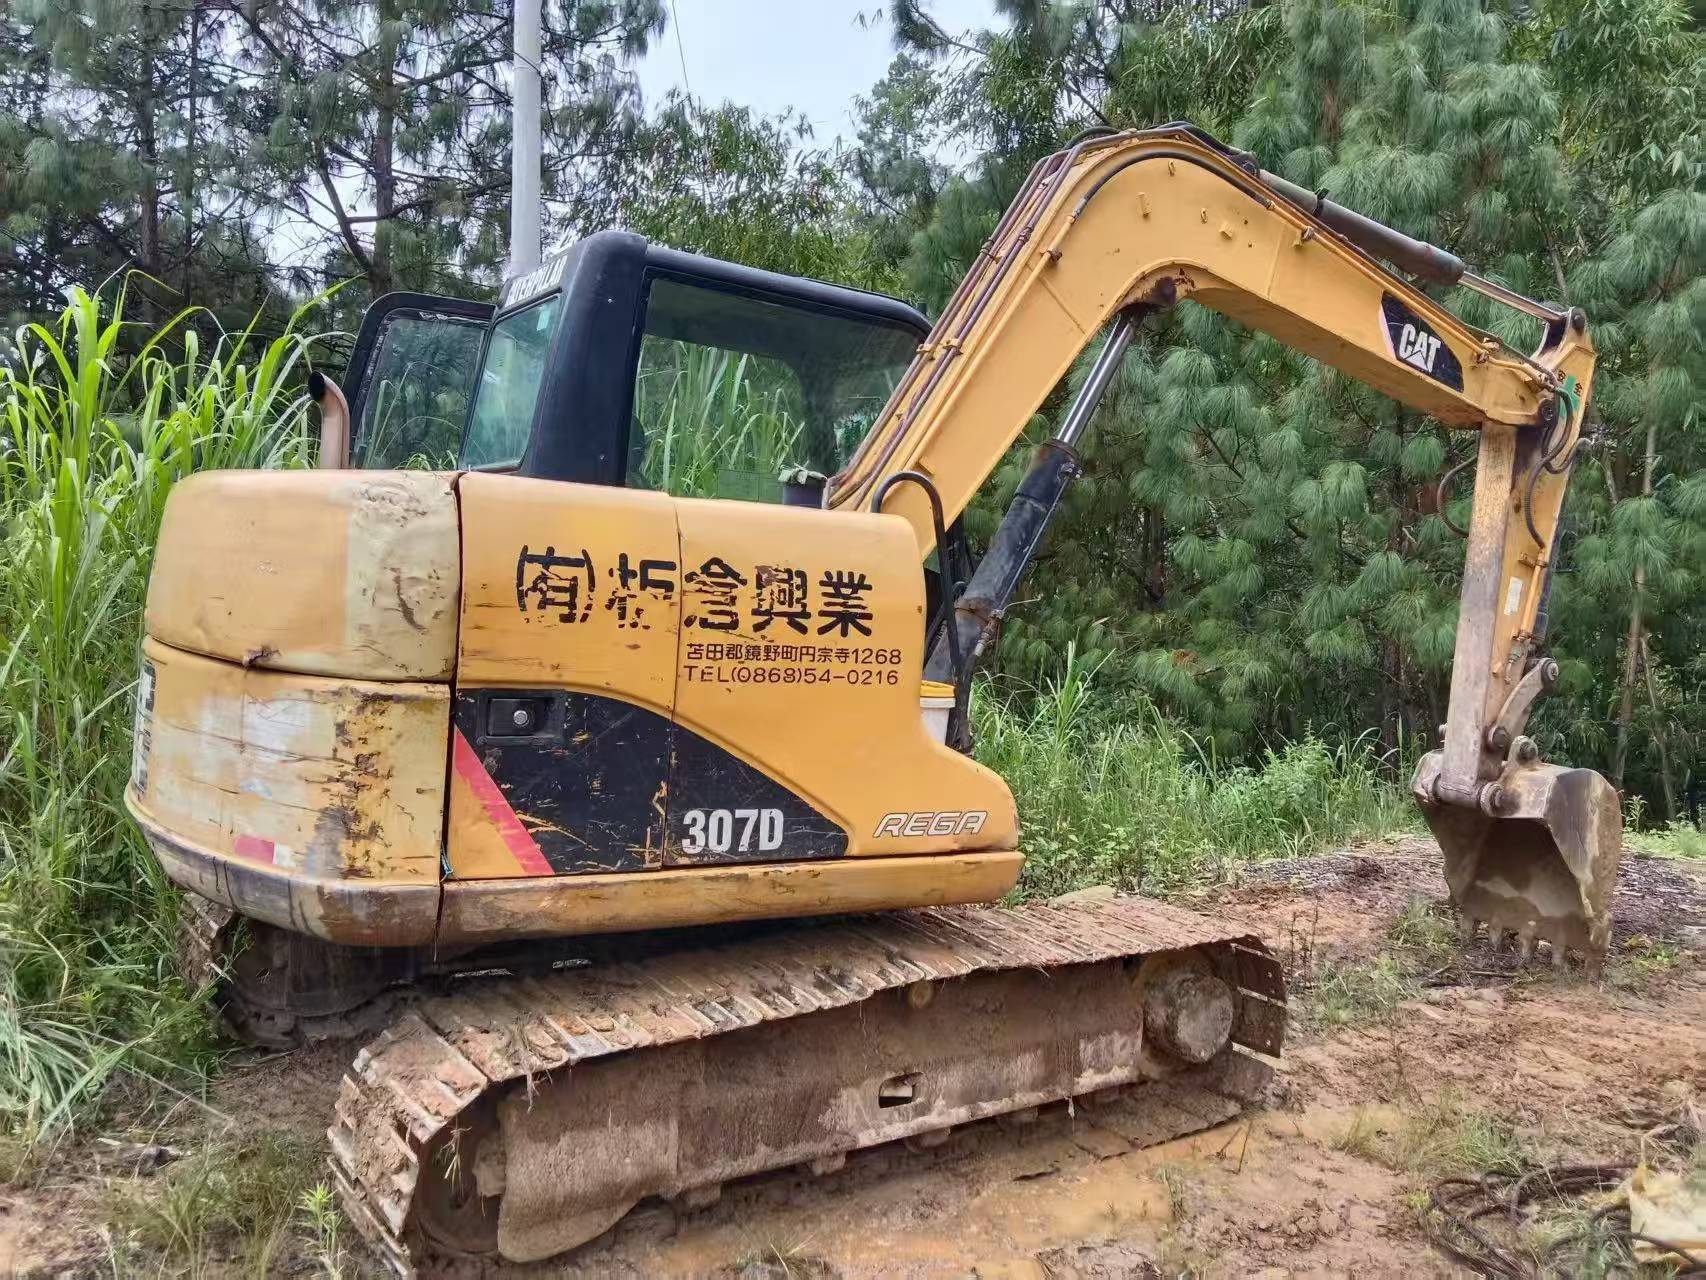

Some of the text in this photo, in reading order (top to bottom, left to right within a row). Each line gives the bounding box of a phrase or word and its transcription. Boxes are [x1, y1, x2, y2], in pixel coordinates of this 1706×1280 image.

[1399, 323, 1441, 373] CAT
[681, 808, 784, 855] 307D
[873, 811, 989, 839] REGA
